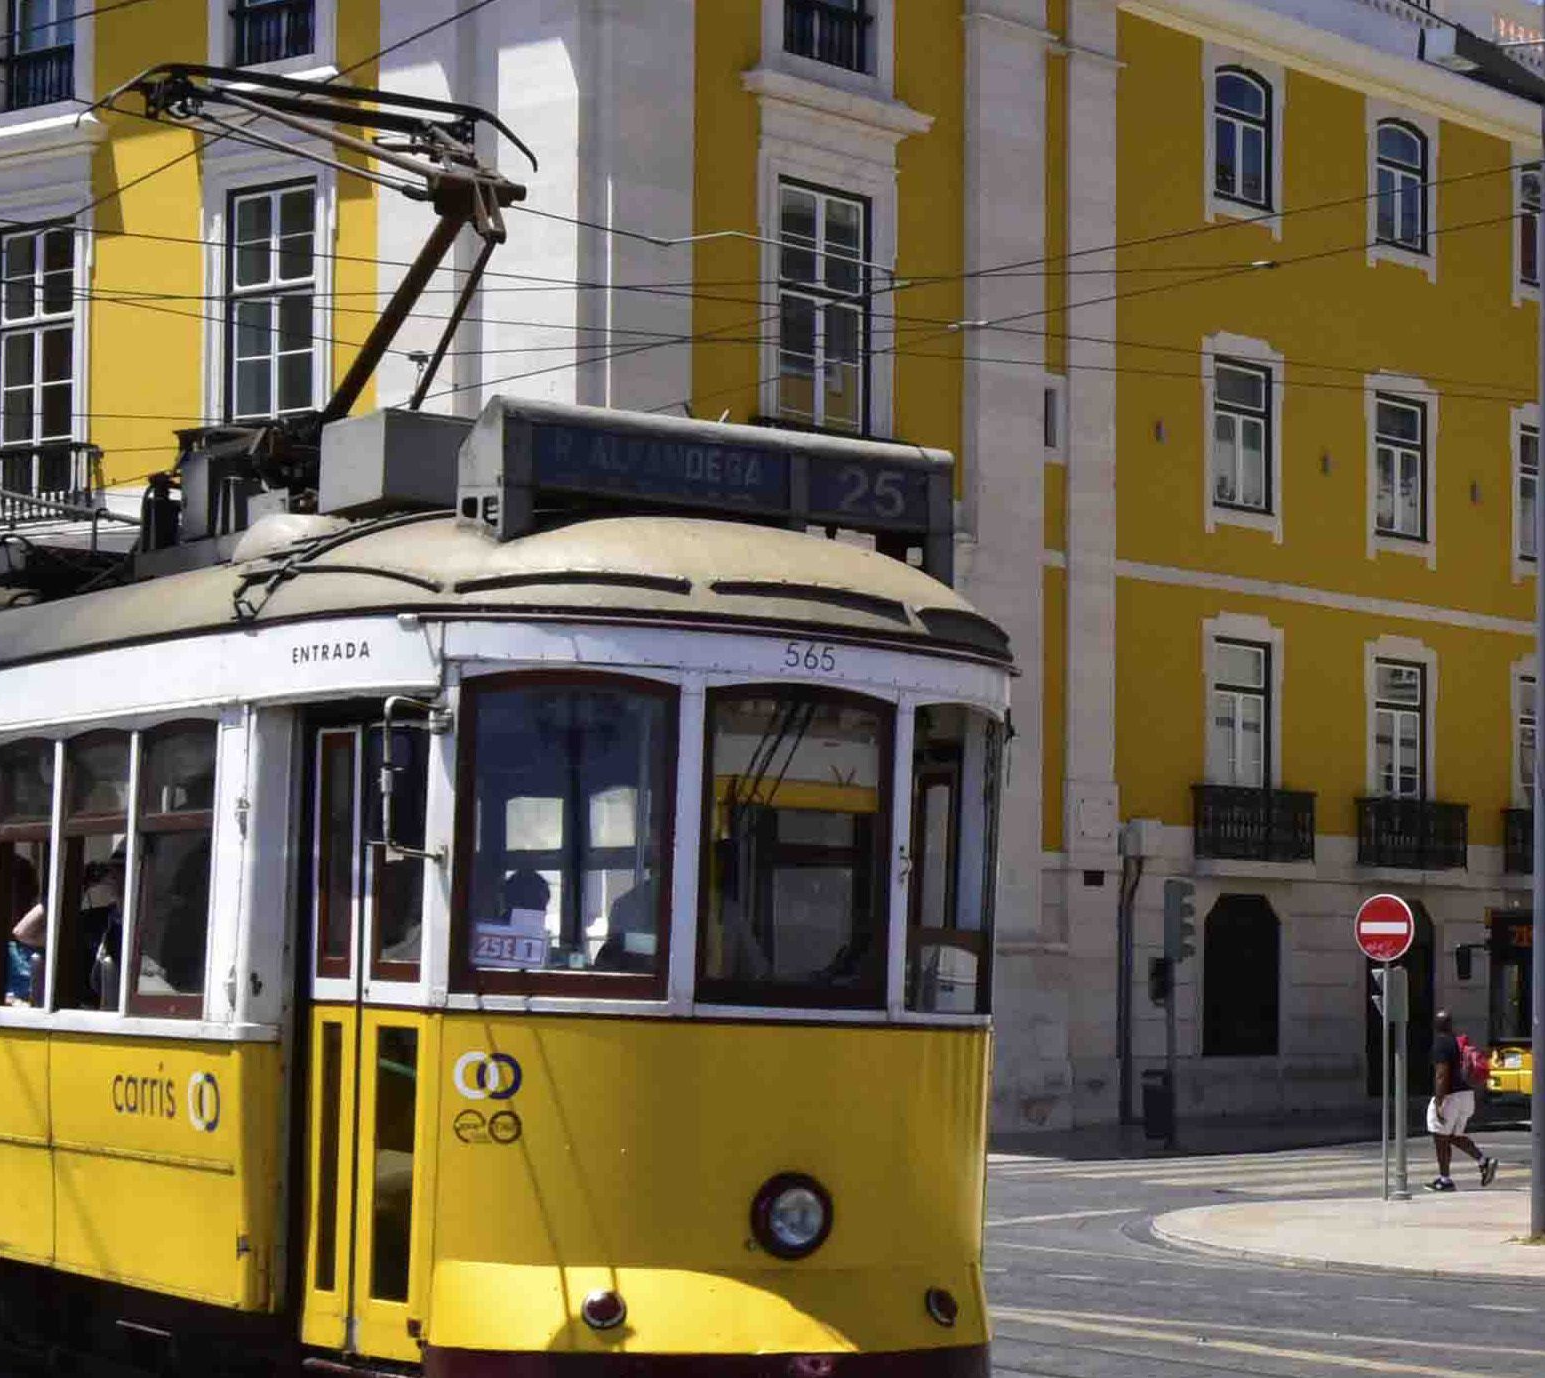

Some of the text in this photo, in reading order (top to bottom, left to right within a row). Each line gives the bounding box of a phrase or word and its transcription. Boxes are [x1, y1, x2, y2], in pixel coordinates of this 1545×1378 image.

[837, 466, 906, 518] 25
[292, 641, 370, 664] ENTRADA
[785, 642, 835, 671] 565
[112, 1061, 176, 1119] carris
